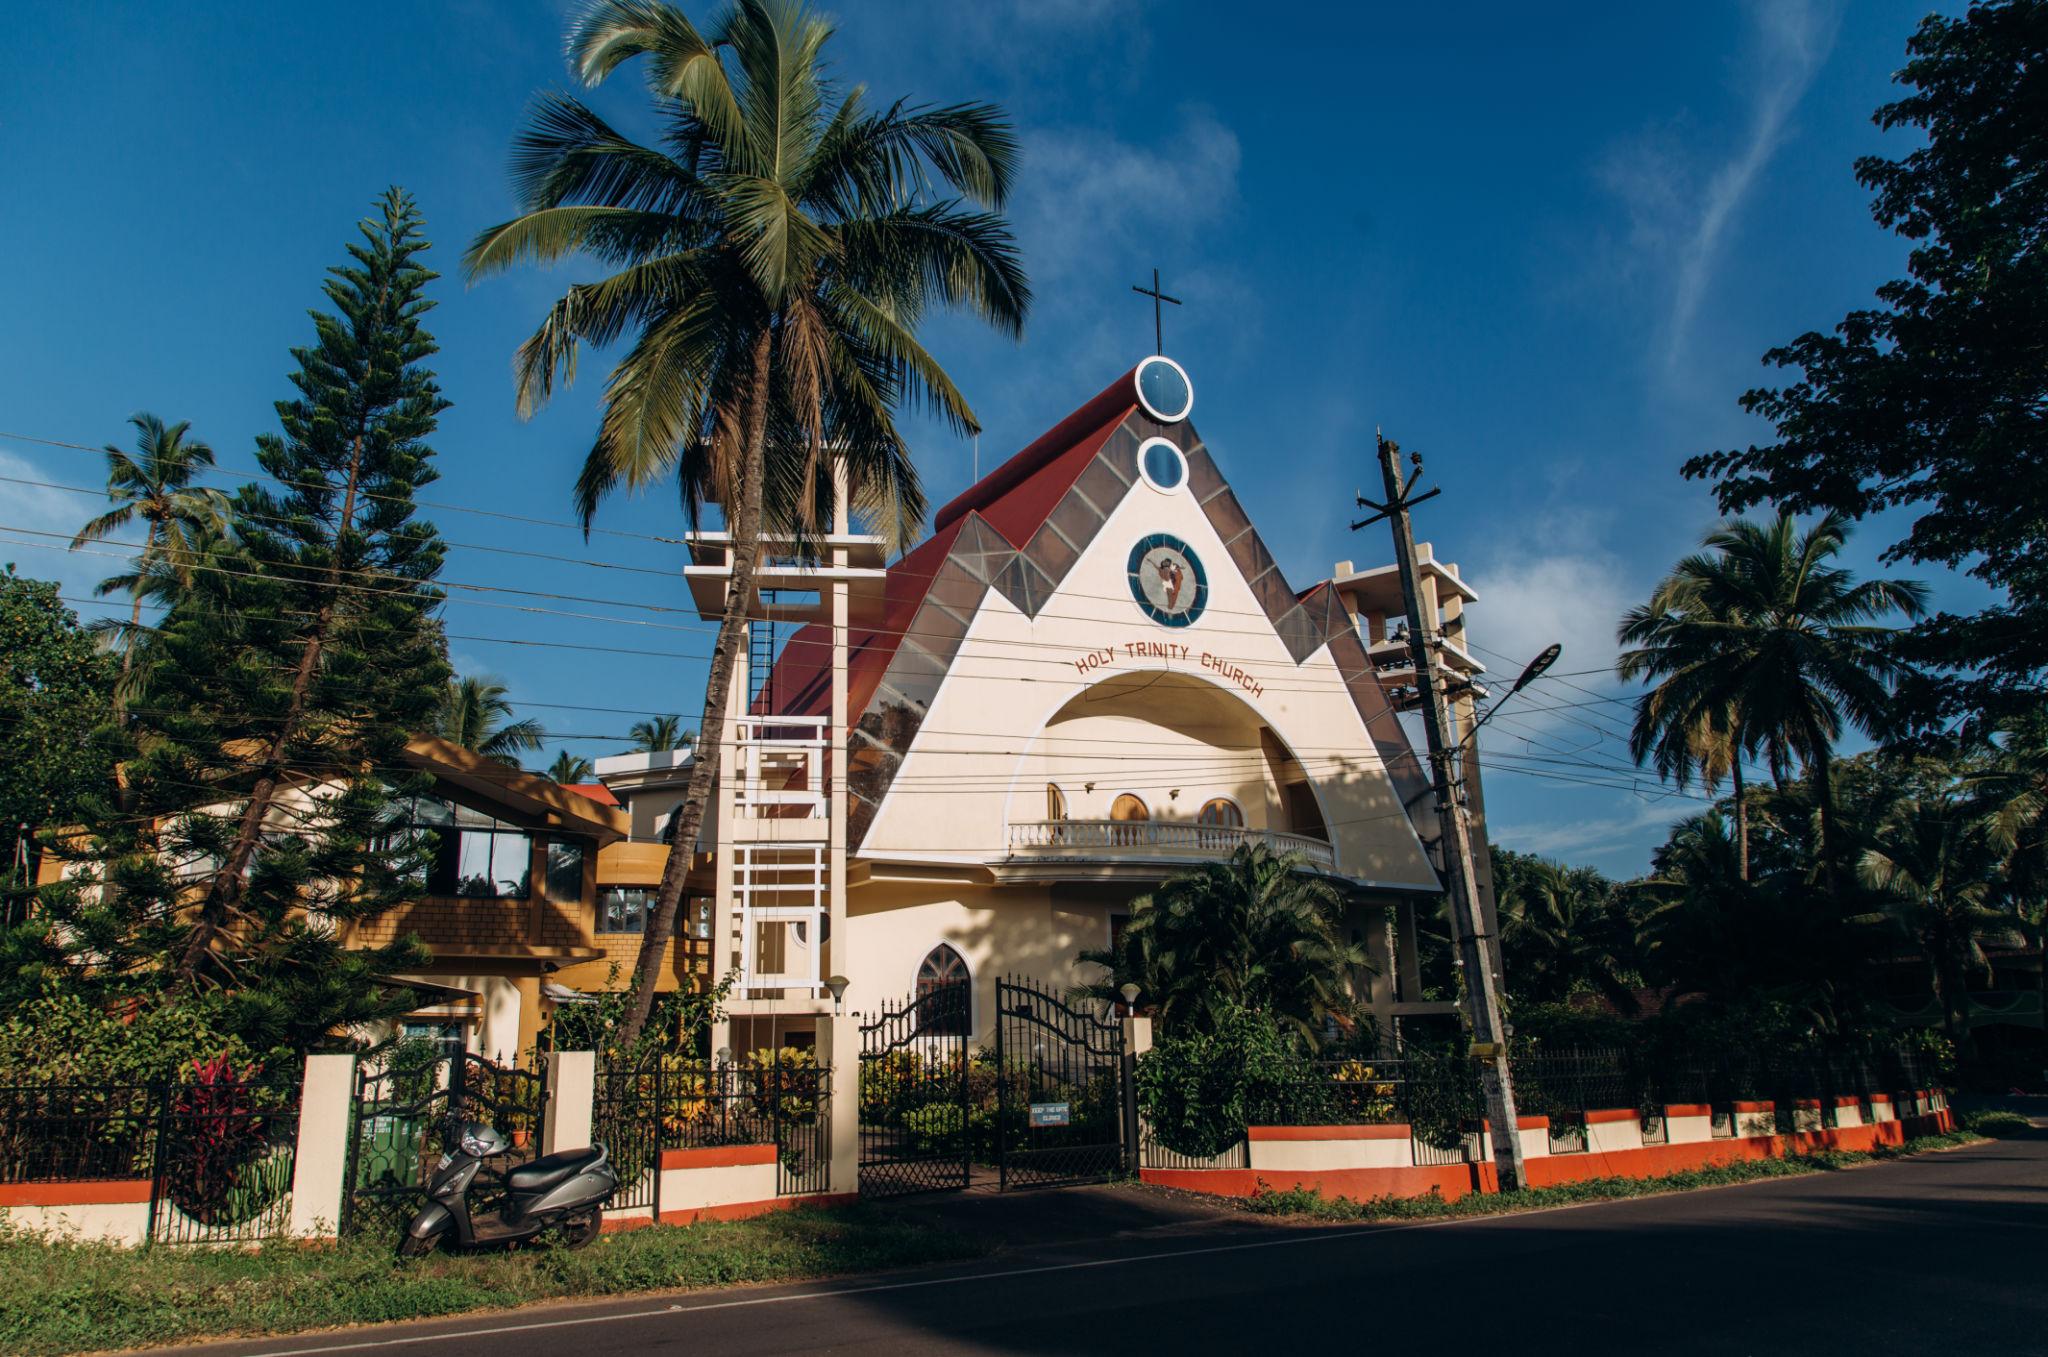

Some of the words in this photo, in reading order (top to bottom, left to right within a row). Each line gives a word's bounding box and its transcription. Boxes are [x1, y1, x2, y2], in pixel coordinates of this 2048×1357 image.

[1075, 646, 1115, 675] HOLY
[1125, 642, 1189, 661] TRINITY
[1201, 652, 1264, 699] CHURCH
